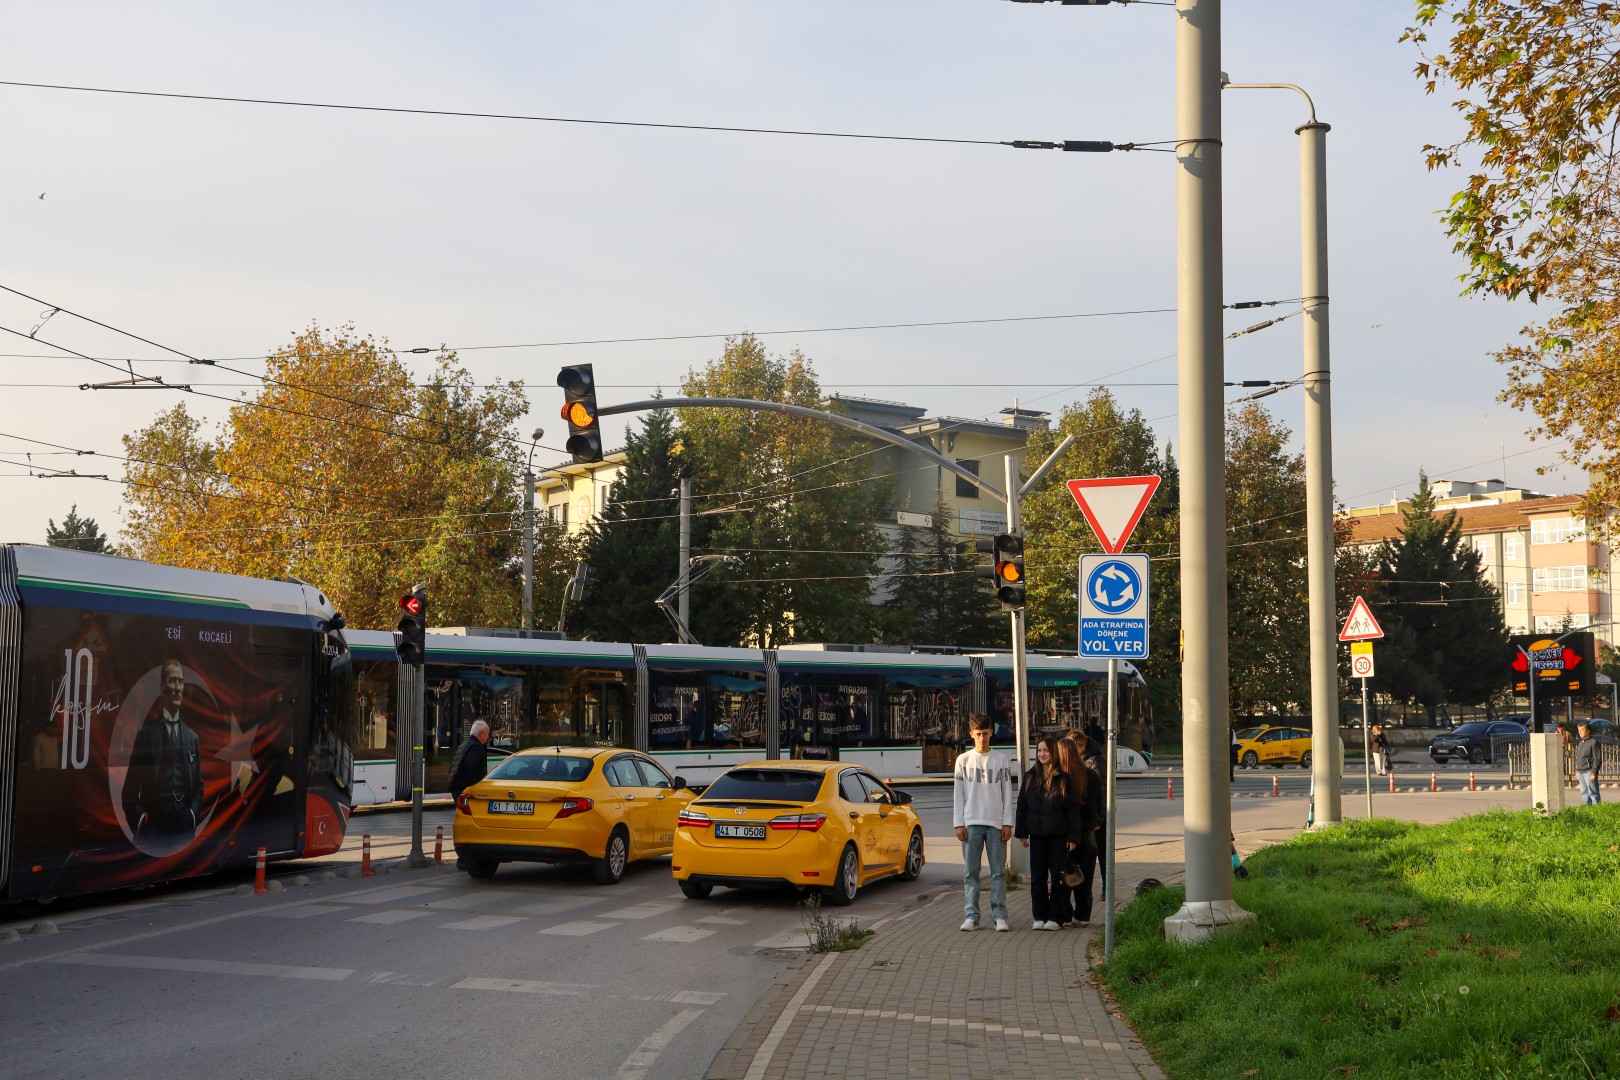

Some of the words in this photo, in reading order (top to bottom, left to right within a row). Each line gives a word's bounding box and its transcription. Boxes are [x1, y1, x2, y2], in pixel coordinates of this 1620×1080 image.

[199, 630, 232, 643] KOCAELİ
[1083, 640, 1110, 651] YOL
[1114, 640, 1143, 652] VER
[1358, 661, 1367, 670] 30
[61, 647, 93, 770] 10
[493, 802, 501, 810] 41
[513, 803, 532, 811] 0444
[720, 826, 729, 835] 41
[734, 826, 740, 835] T
[743, 827, 765, 836] 0508
